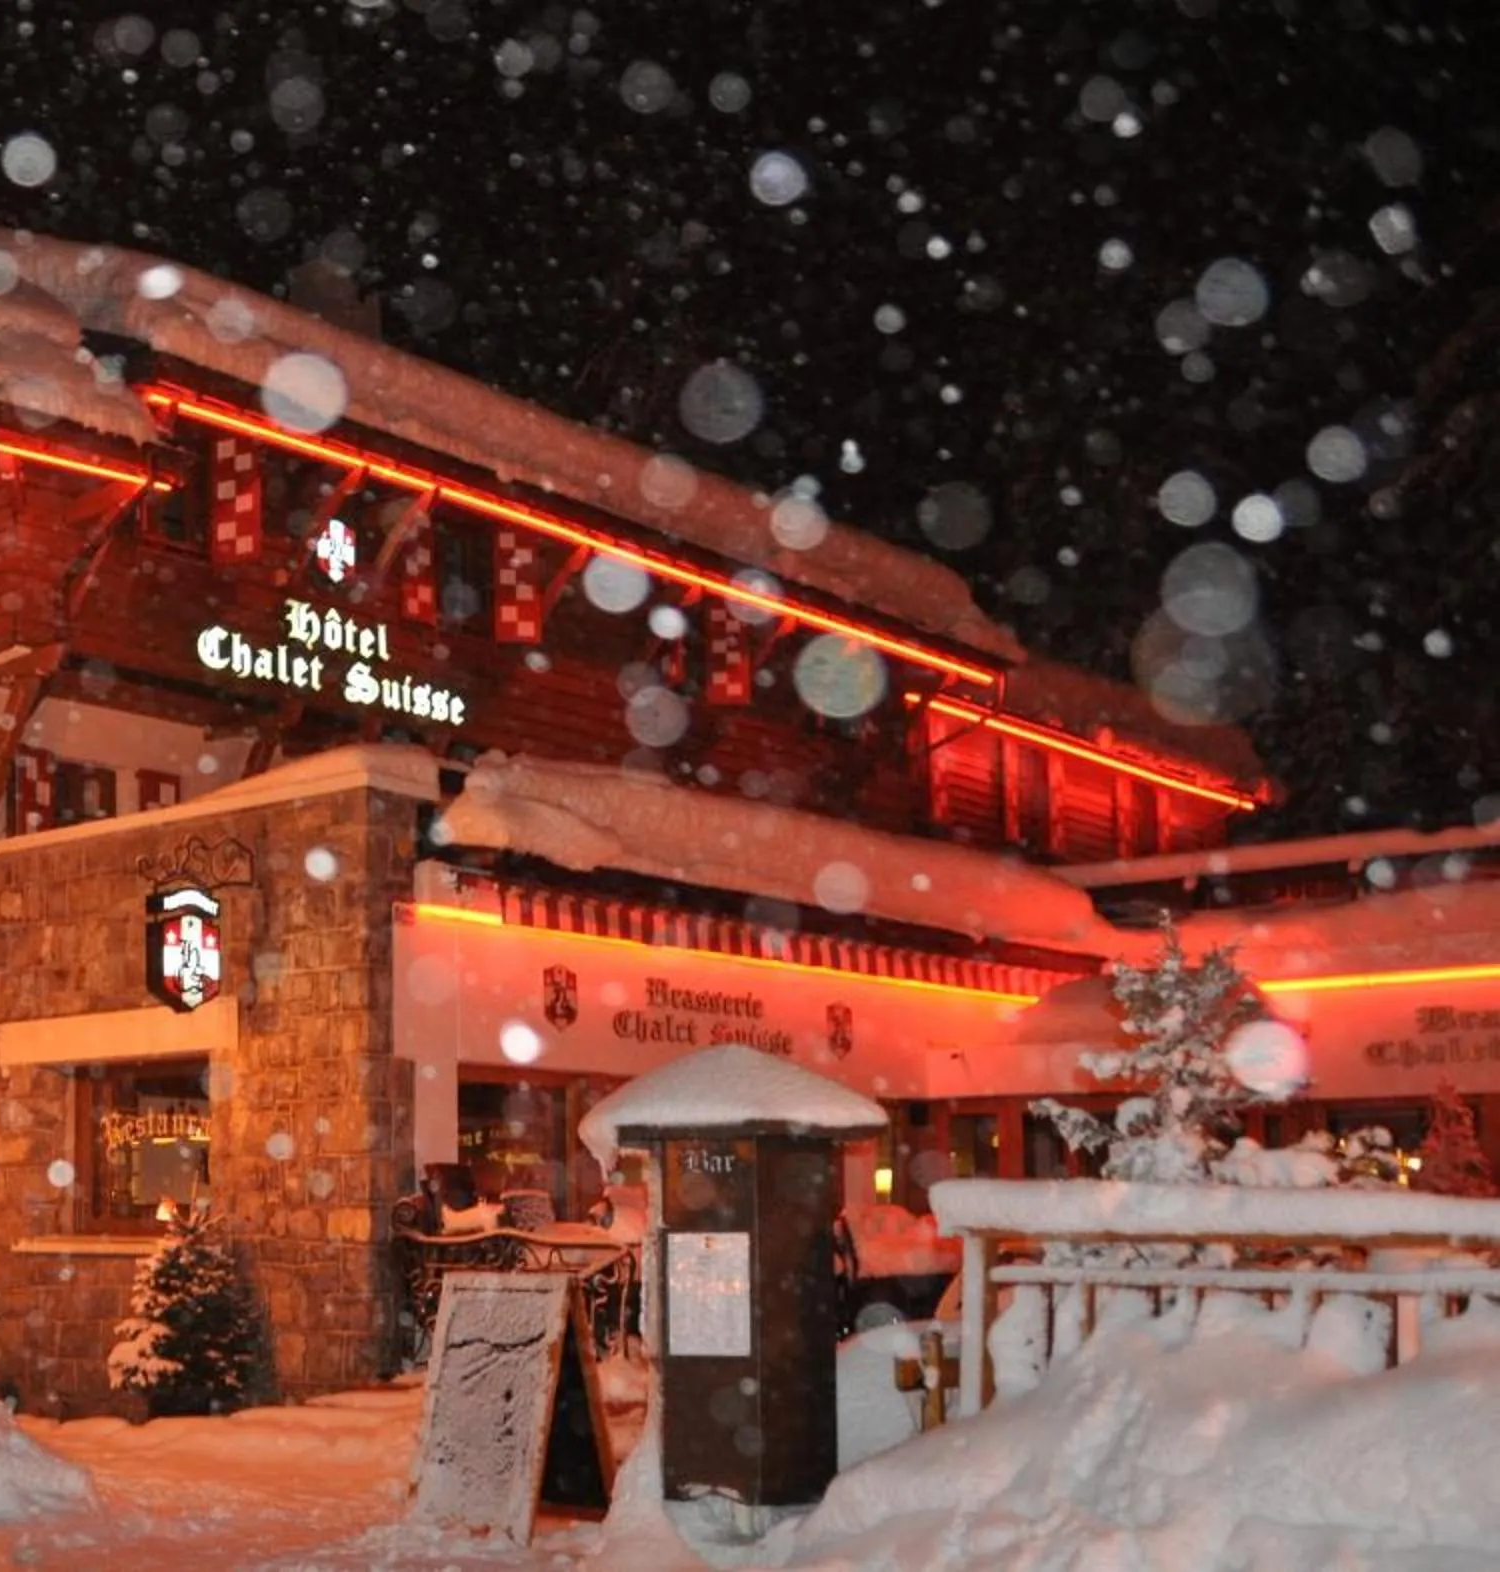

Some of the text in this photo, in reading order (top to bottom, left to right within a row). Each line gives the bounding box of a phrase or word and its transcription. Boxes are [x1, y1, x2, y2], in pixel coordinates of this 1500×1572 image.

[285, 598, 390, 661] Hôtel
[197, 624, 465, 726] Chalet Suisse
[646, 977, 763, 1018] Brasserie
[613, 1009, 699, 1045] Chalet
[684, 1150, 736, 1173] Bar
